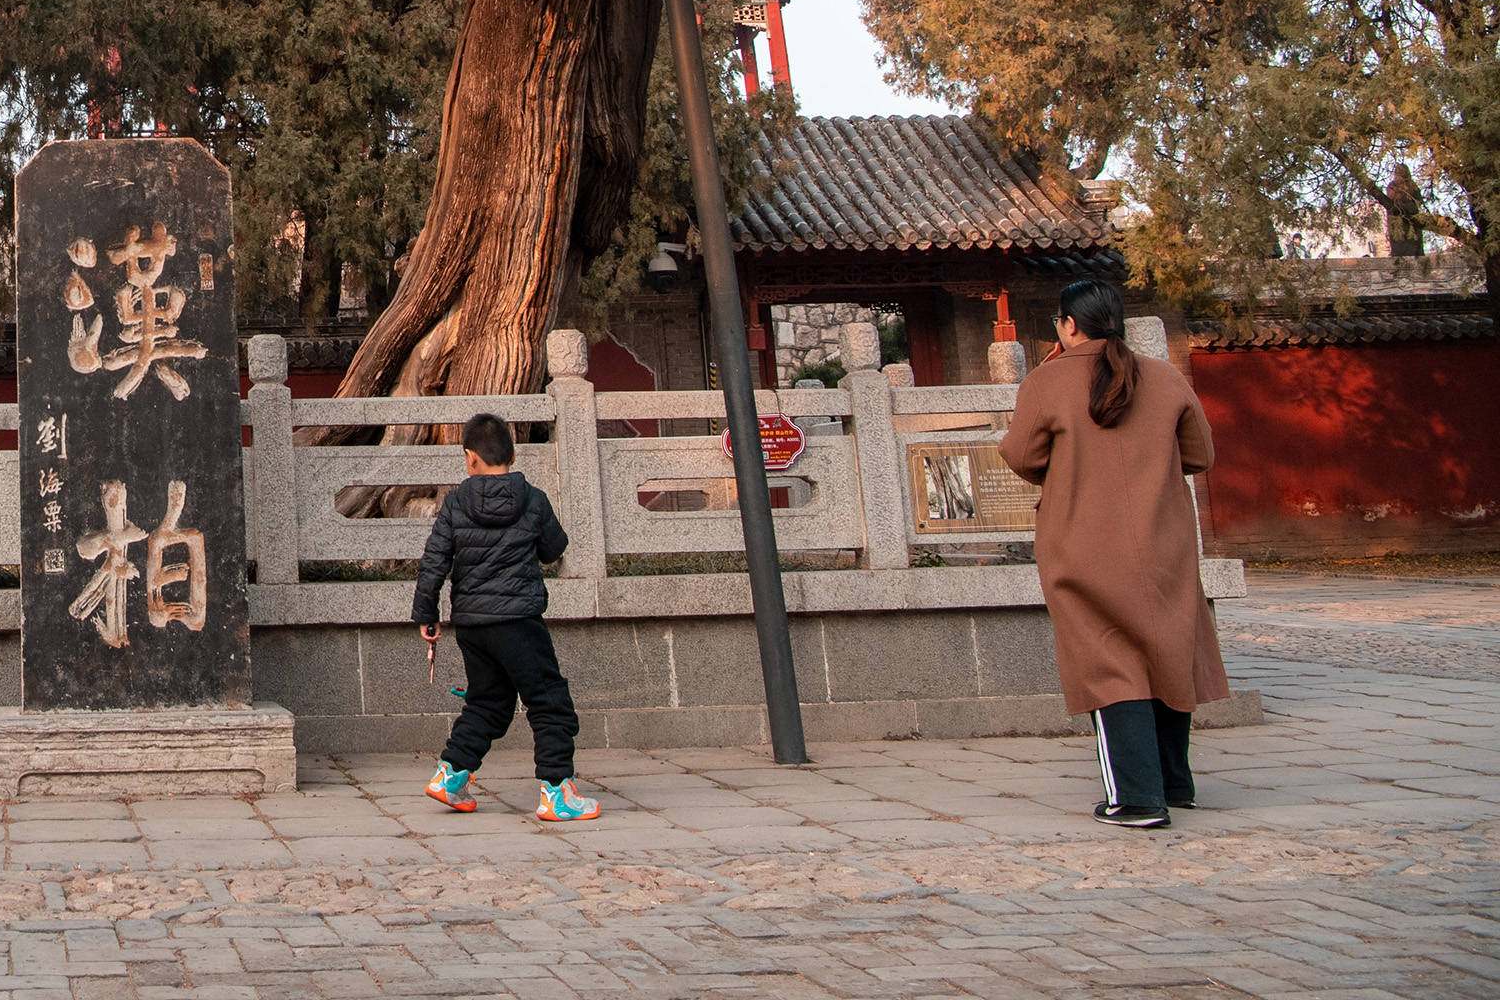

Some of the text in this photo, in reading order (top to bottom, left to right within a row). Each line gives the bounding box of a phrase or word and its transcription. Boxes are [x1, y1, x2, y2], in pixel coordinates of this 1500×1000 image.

[35, 411, 67, 532] 劉海粟
[65, 222, 207, 648] 漢柏
